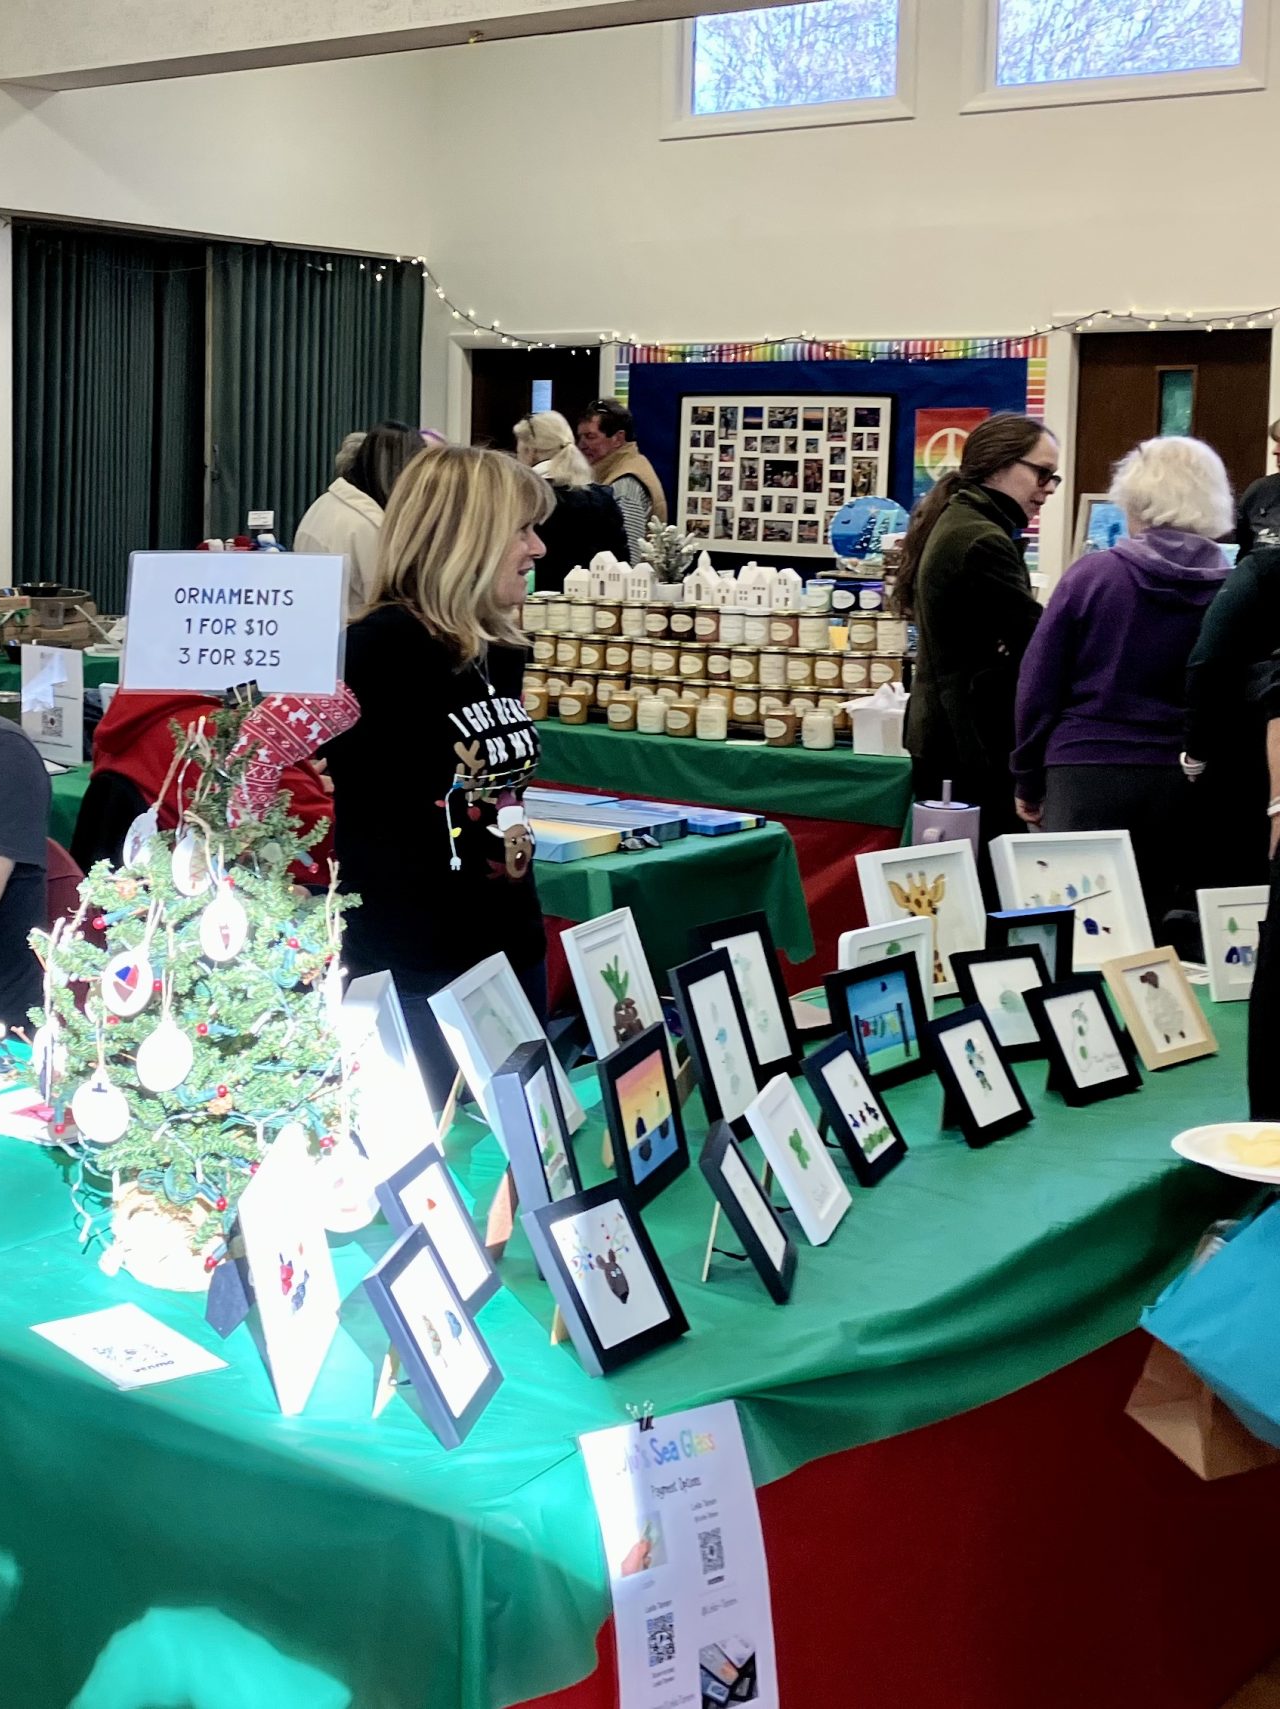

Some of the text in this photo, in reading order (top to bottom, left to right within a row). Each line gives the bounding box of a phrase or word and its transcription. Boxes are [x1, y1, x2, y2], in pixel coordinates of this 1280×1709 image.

[174, 587, 294, 606] ORNAMENTS
[185, 618, 279, 636] 1 FOR $10
[178, 648, 281, 667] 3 FOR $25
[448, 713, 471, 738] I
[462, 700, 496, 733] GOT
[649, 1437, 680, 1466] Sea
